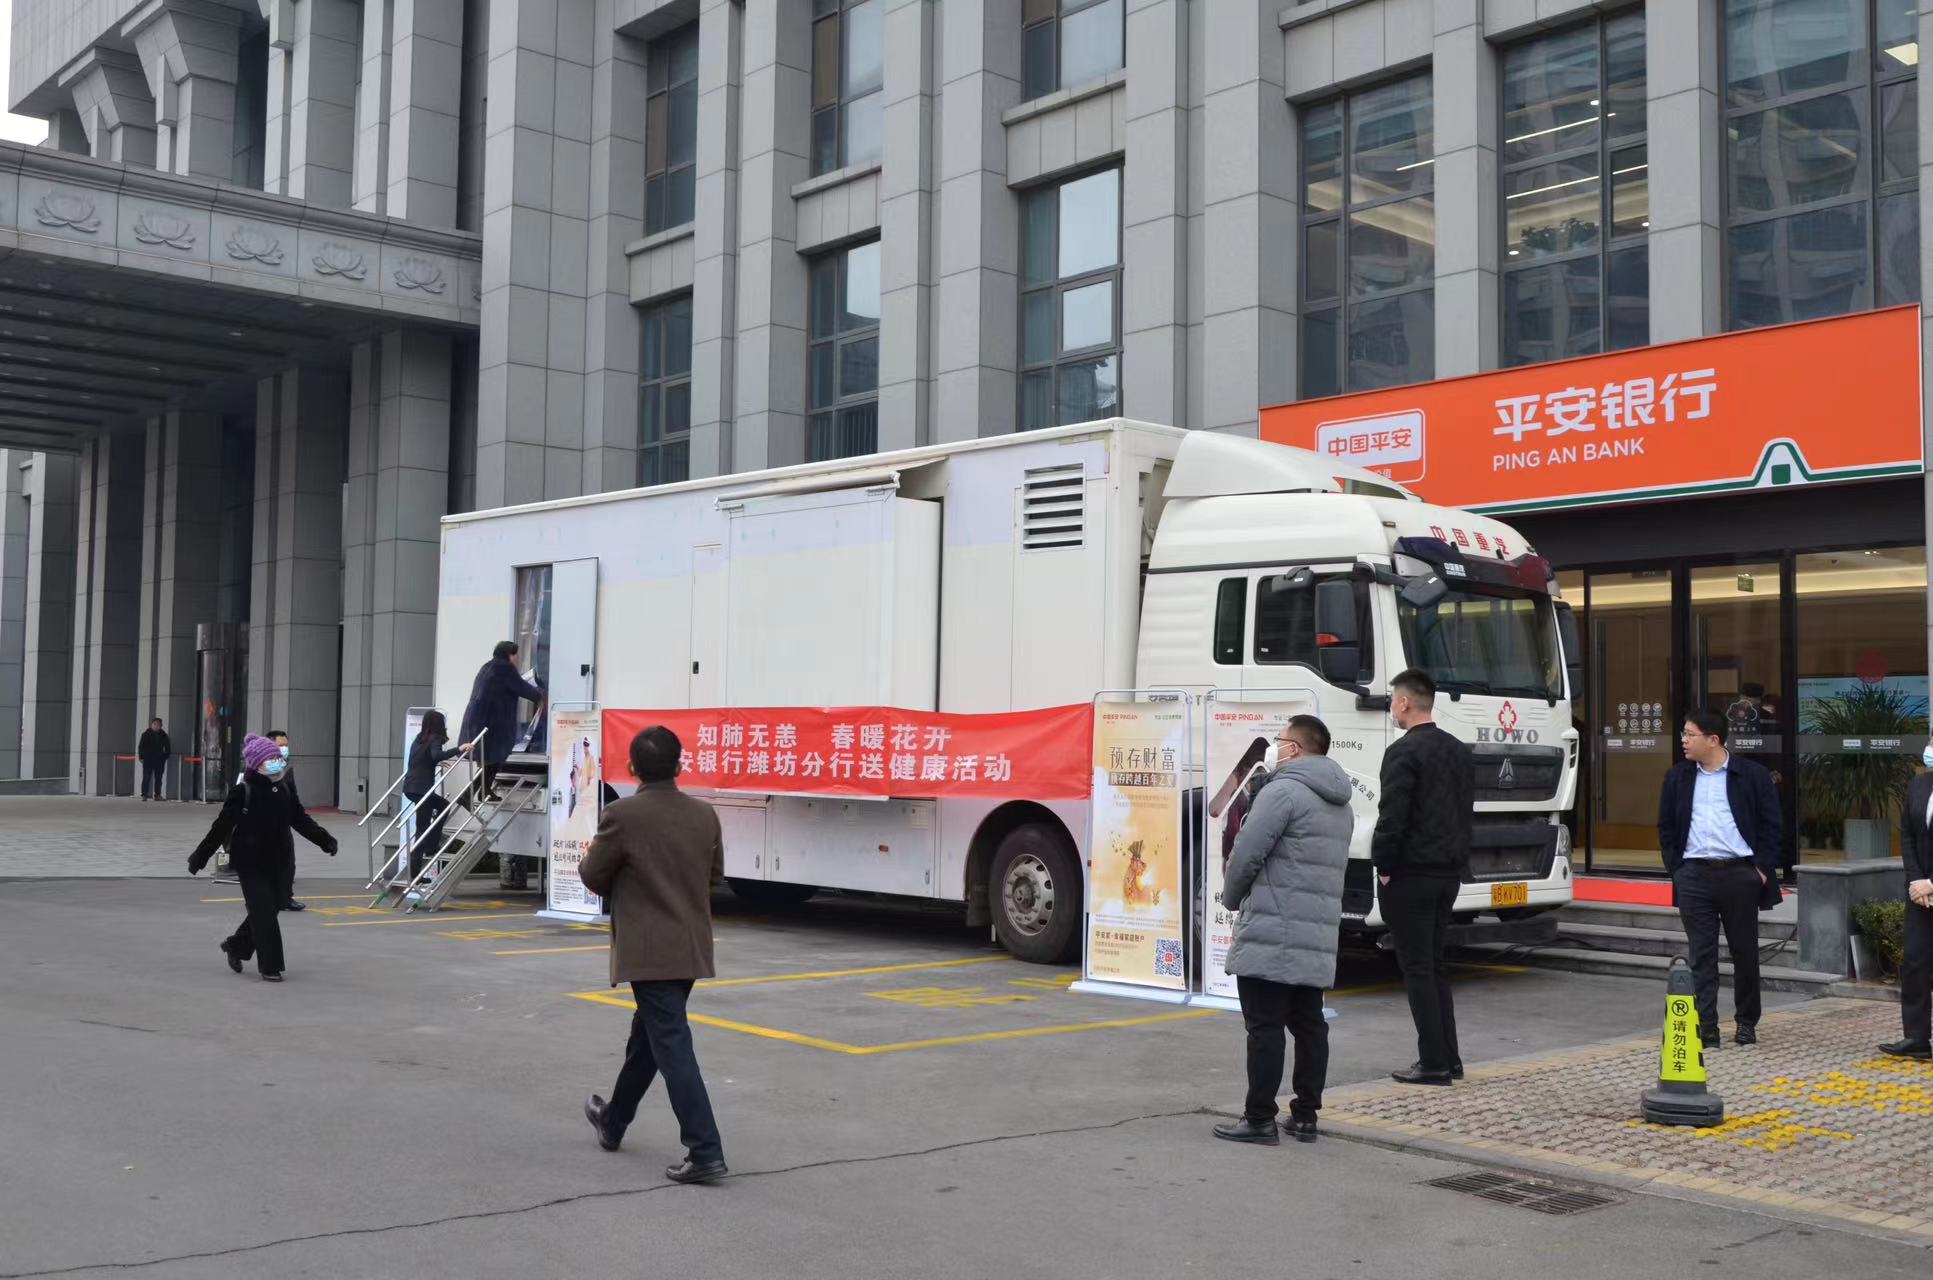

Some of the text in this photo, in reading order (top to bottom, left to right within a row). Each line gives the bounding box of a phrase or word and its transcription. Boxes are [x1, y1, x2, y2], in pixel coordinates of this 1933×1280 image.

[1493, 368, 1717, 442] 平安银行
[1328, 428, 1411, 456] 中国平安
[1493, 437, 1644, 471] PING AN BANK
[697, 723, 951, 751] 知肺无恙 春暖花开
[1477, 727, 1539, 744] HOWO
[680, 749, 1011, 781] 安银行潍坊分行送健康活动
[1109, 746, 1175, 771] 预存财富
[1672, 1020, 1686, 1073] 请勿泊车
